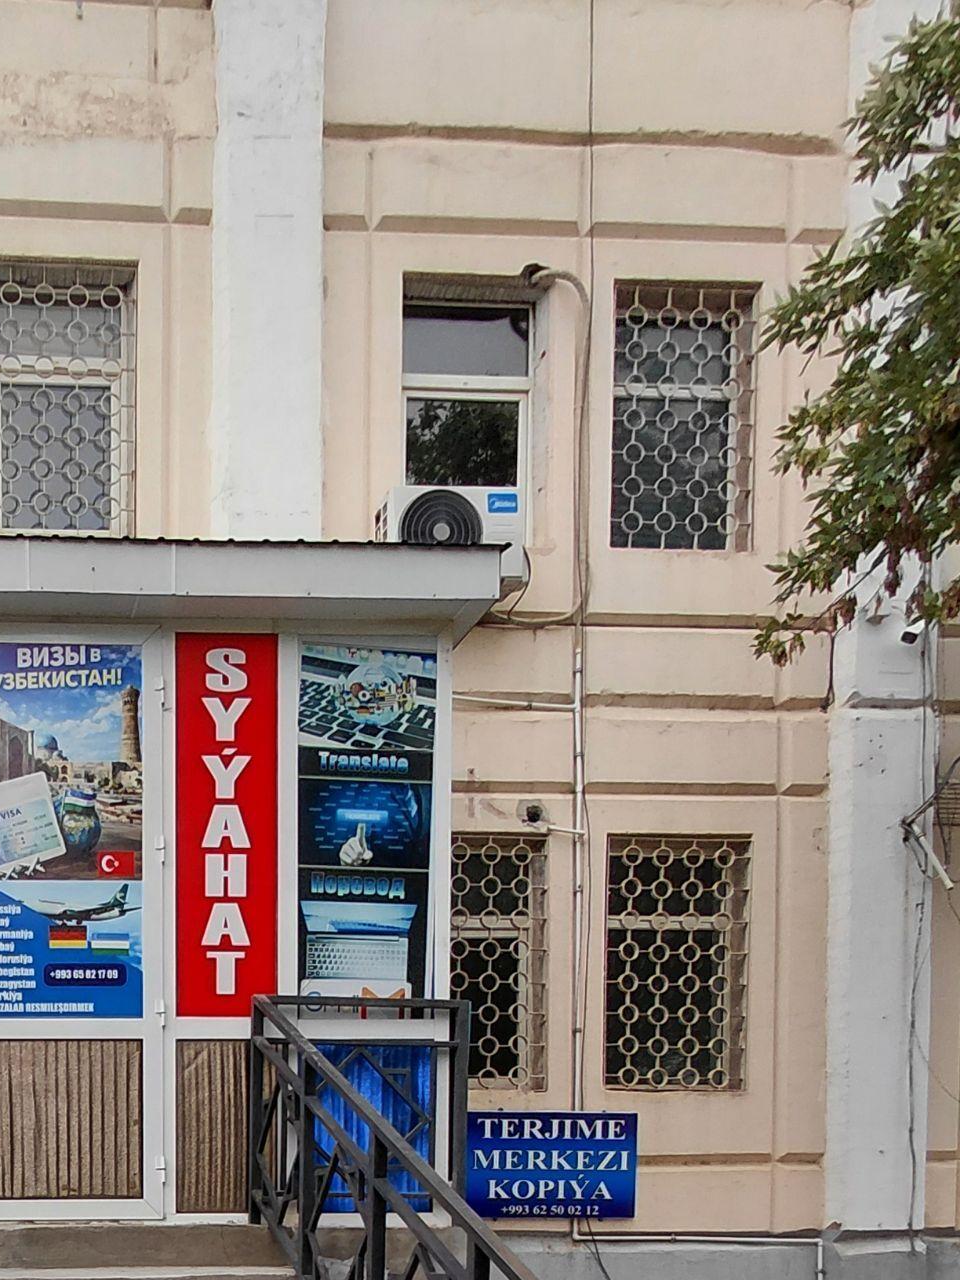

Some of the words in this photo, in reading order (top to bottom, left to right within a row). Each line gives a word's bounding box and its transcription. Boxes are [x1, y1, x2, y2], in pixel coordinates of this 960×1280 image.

[17, 646, 86, 668] ВИЗЫ
[318, 750, 409, 774] Translate
[0, 808, 22, 820] VISA
[201, 648, 252, 995] SYÝAHAT
[49, 969, 71, 979] +993
[477, 1118, 627, 1140] TERJIME
[472, 1149, 631, 1171] MERKEZI
[487, 1174, 613, 1200] KOPIÝA
[501, 1205, 529, 1215] +993
[532, 1205, 547, 1215] 62
[550, 1205, 564, 1215] 50
[568, 1205, 581, 1215] 02
[586, 1205, 600, 1216] 12
